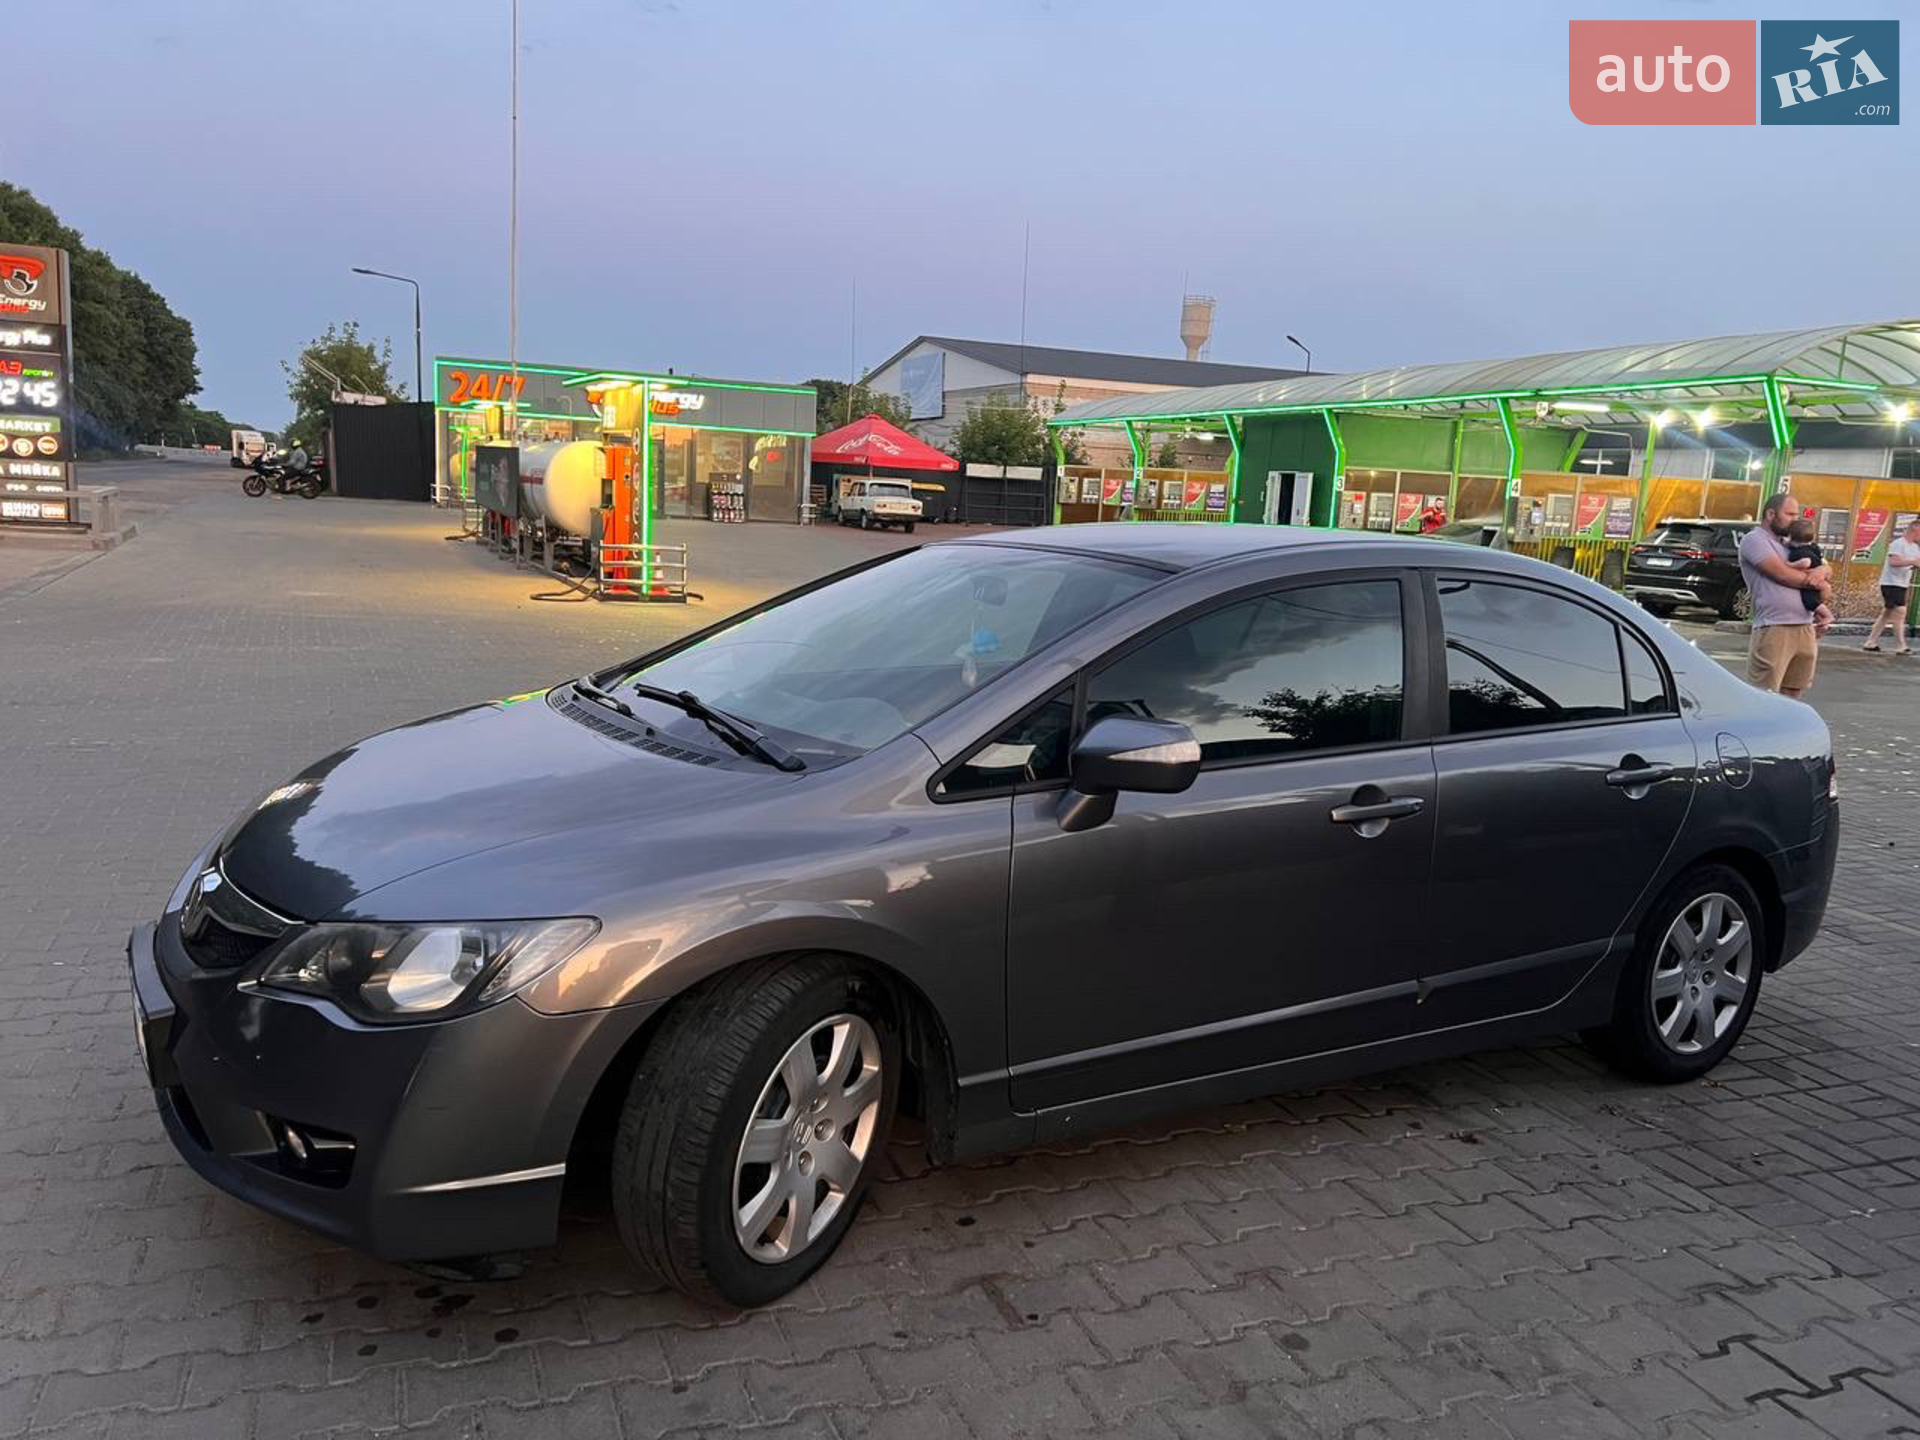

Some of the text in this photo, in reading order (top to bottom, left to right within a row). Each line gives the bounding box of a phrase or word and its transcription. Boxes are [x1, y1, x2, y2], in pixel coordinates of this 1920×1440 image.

[449, 371, 526, 404] 24/7
[650, 391, 705, 410] nergy
[651, 401, 680, 415] lus
[1512, 481, 1519, 493] 4
[1781, 478, 1788, 492] 5
